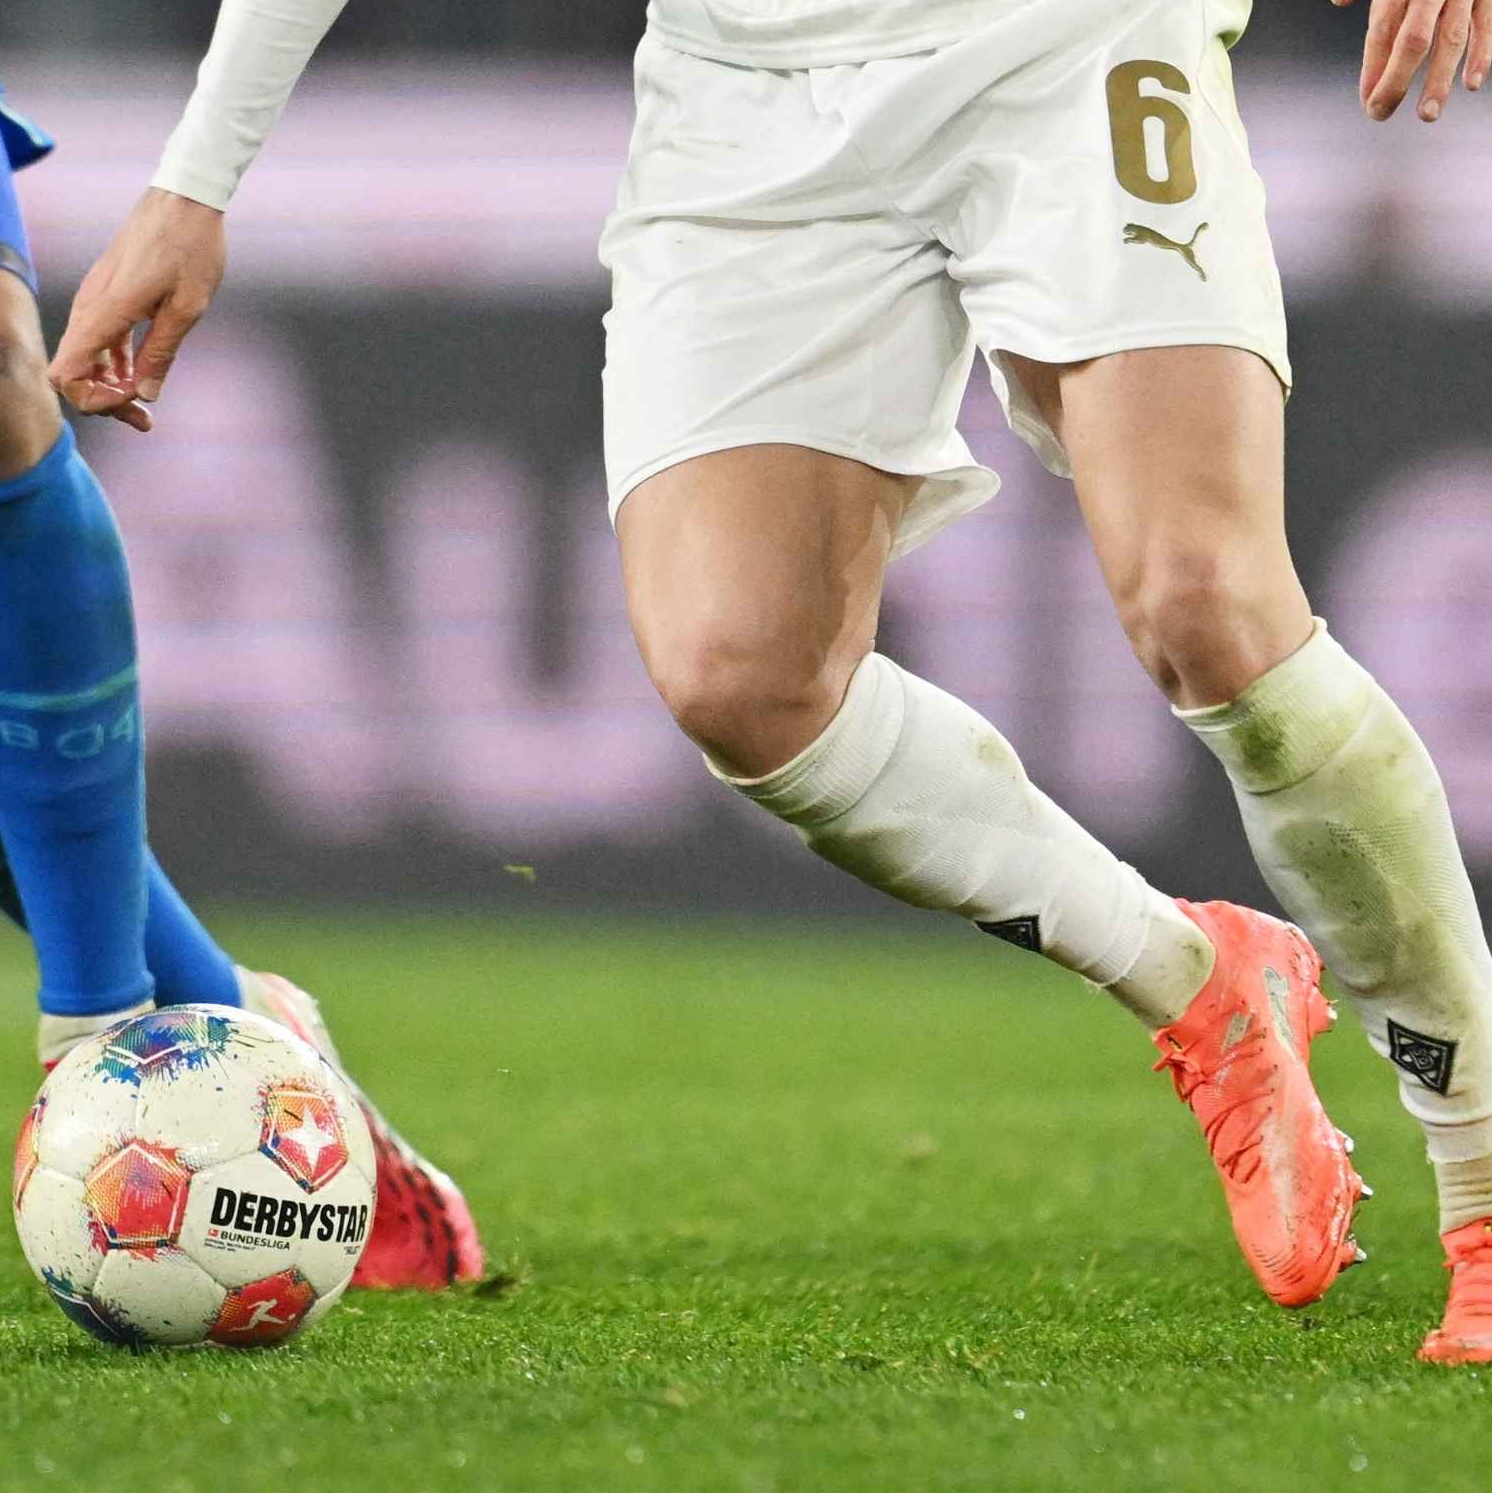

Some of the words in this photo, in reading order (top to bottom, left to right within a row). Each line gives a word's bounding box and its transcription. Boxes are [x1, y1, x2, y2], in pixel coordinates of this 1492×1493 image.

[1105, 59, 1198, 205] 6
[210, 1187, 369, 1244] DERBYSTAR
[220, 1232, 291, 1251] BUNDESLIGA
